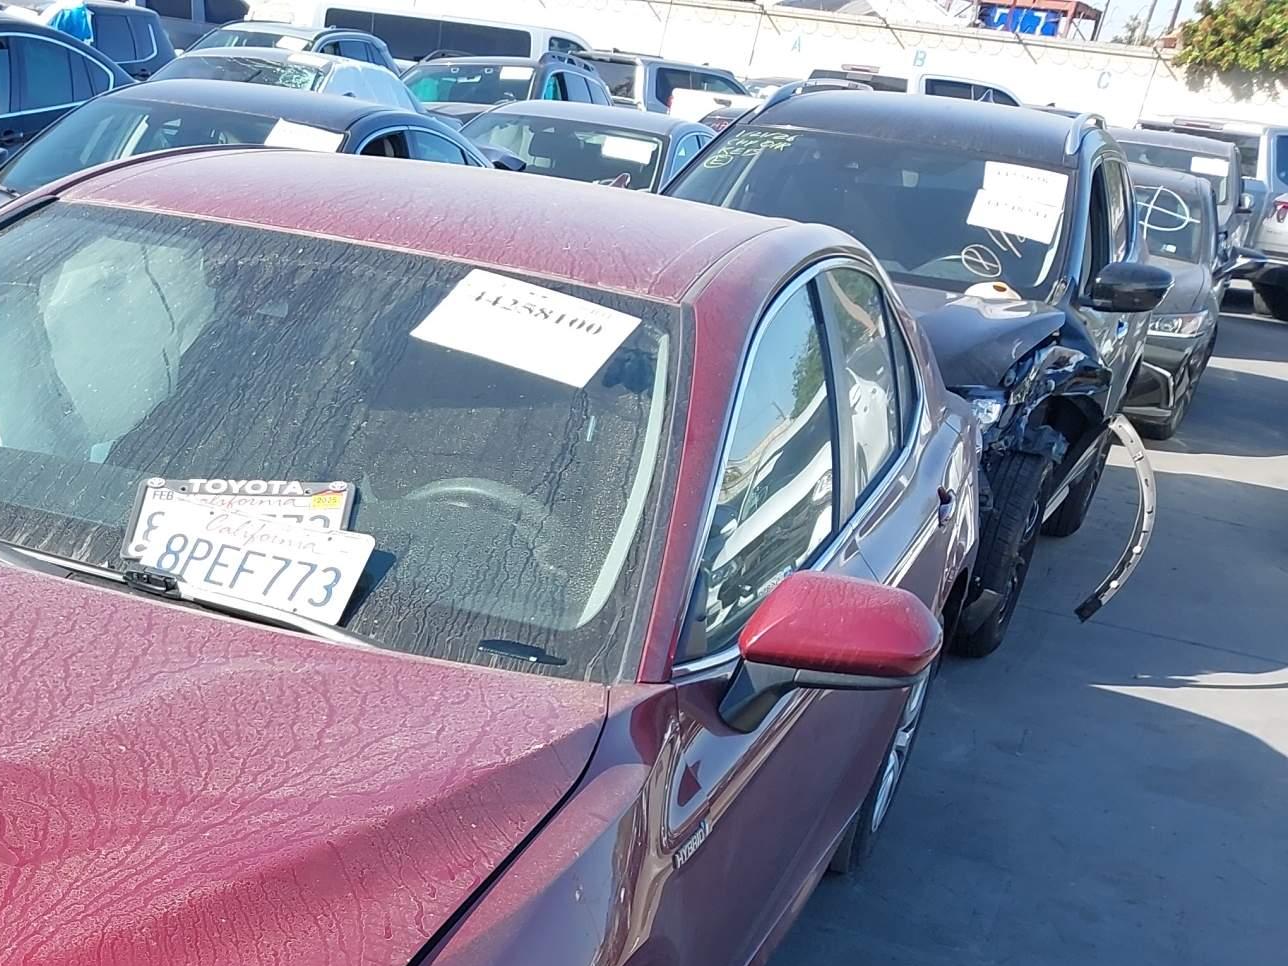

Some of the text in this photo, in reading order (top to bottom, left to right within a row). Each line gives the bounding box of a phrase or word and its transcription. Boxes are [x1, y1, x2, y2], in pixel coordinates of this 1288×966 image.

[912, 50, 928, 68] B
[1095, 71, 1112, 90] C
[152, 490, 174, 501] FEB
[189, 479, 305, 495] TOYOTA
[199, 493, 301, 510] alifornia
[205, 513, 319, 554] California
[156, 533, 342, 607] 8PEF773
[674, 828, 706, 869] HYBRID
